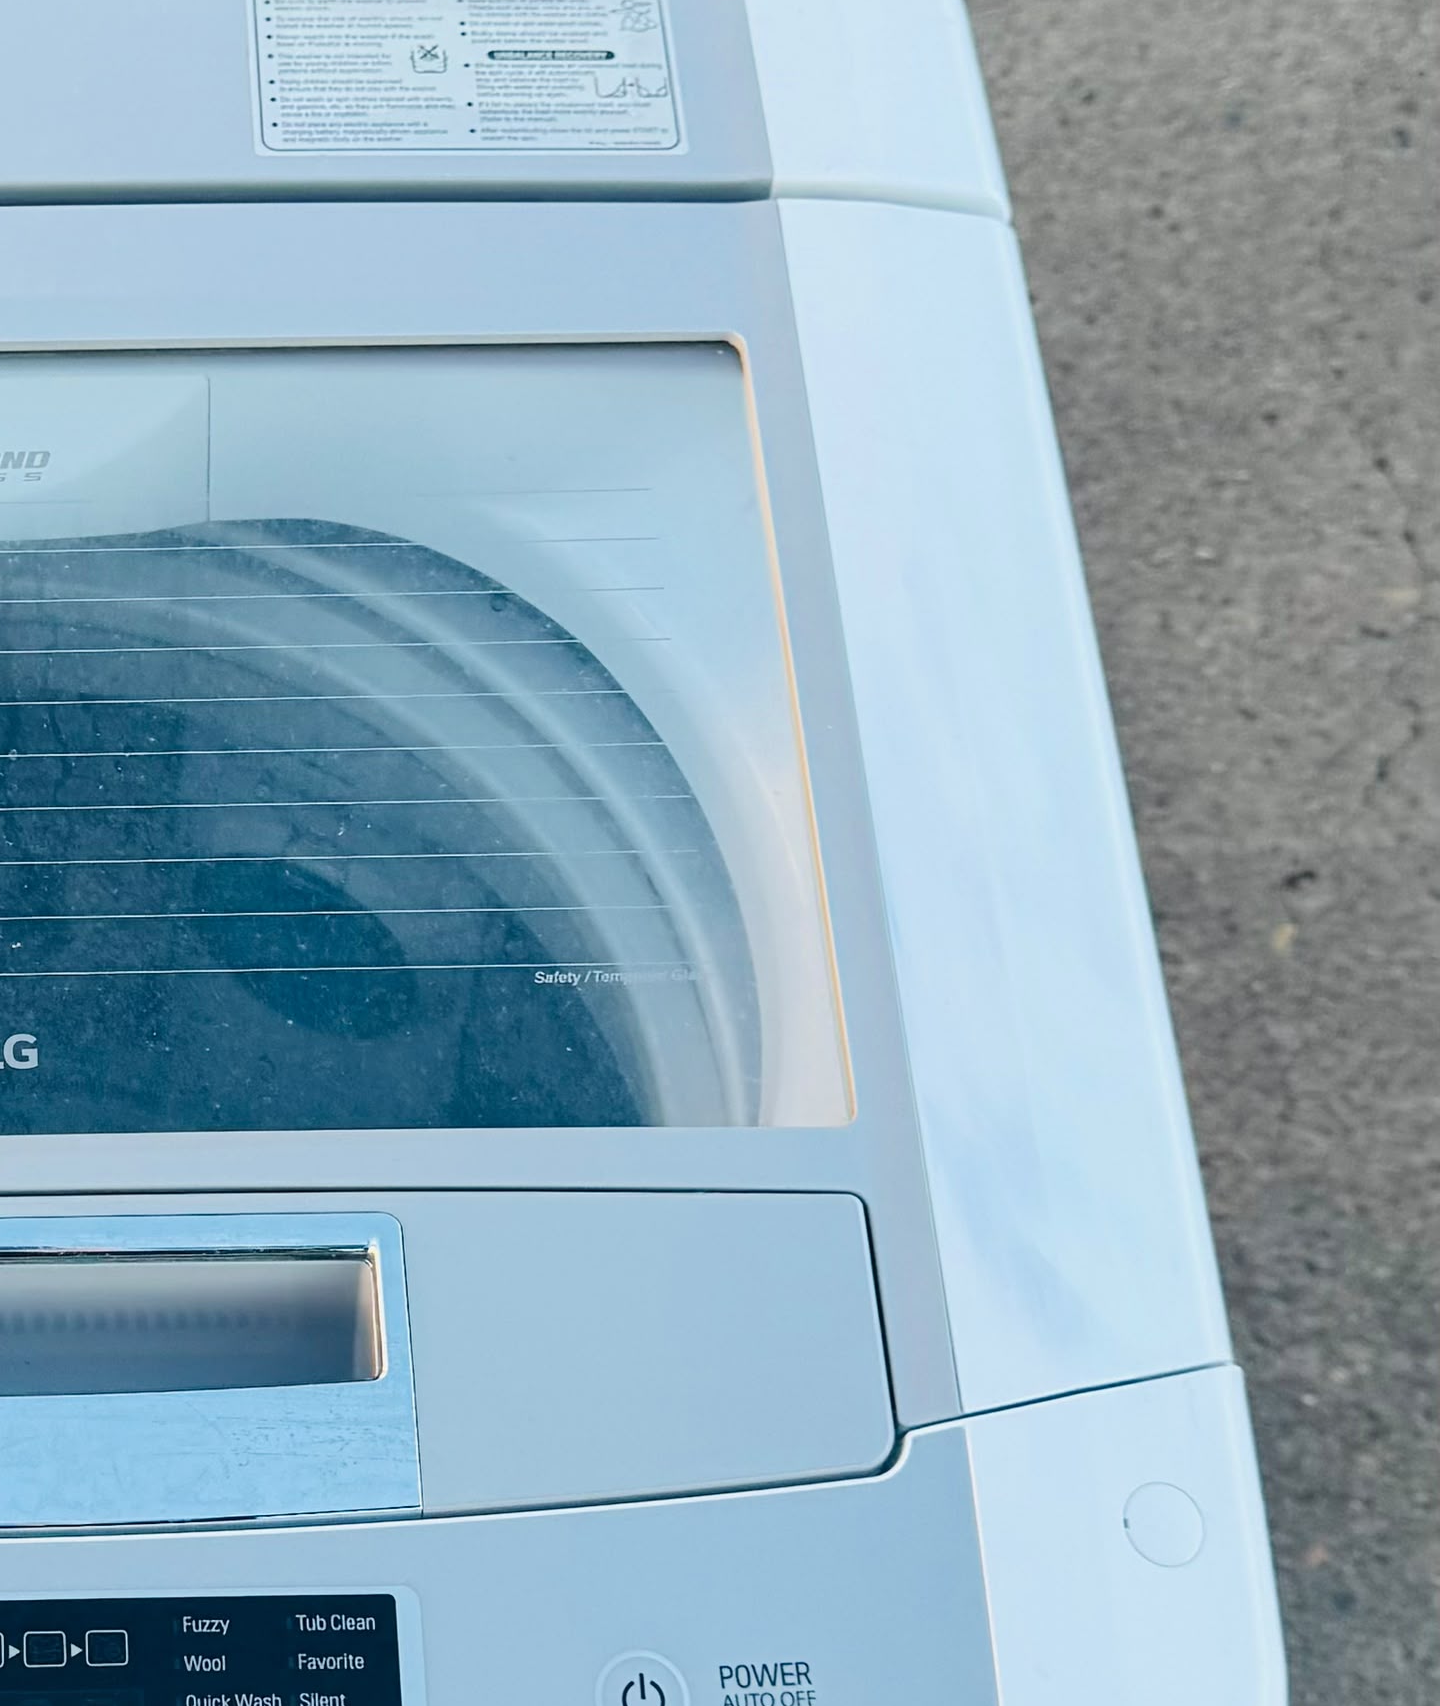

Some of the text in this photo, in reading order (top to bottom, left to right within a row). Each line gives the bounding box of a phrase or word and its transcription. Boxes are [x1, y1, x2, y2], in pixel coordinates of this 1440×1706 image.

[534, 970, 581, 987] Safety
[182, 1615, 230, 1636] Fuzzy
[295, 1614, 376, 1632] Tub Clean
[183, 1654, 226, 1672] Wool
[297, 1652, 365, 1670] Favorite
[718, 1661, 813, 1690] POWER
